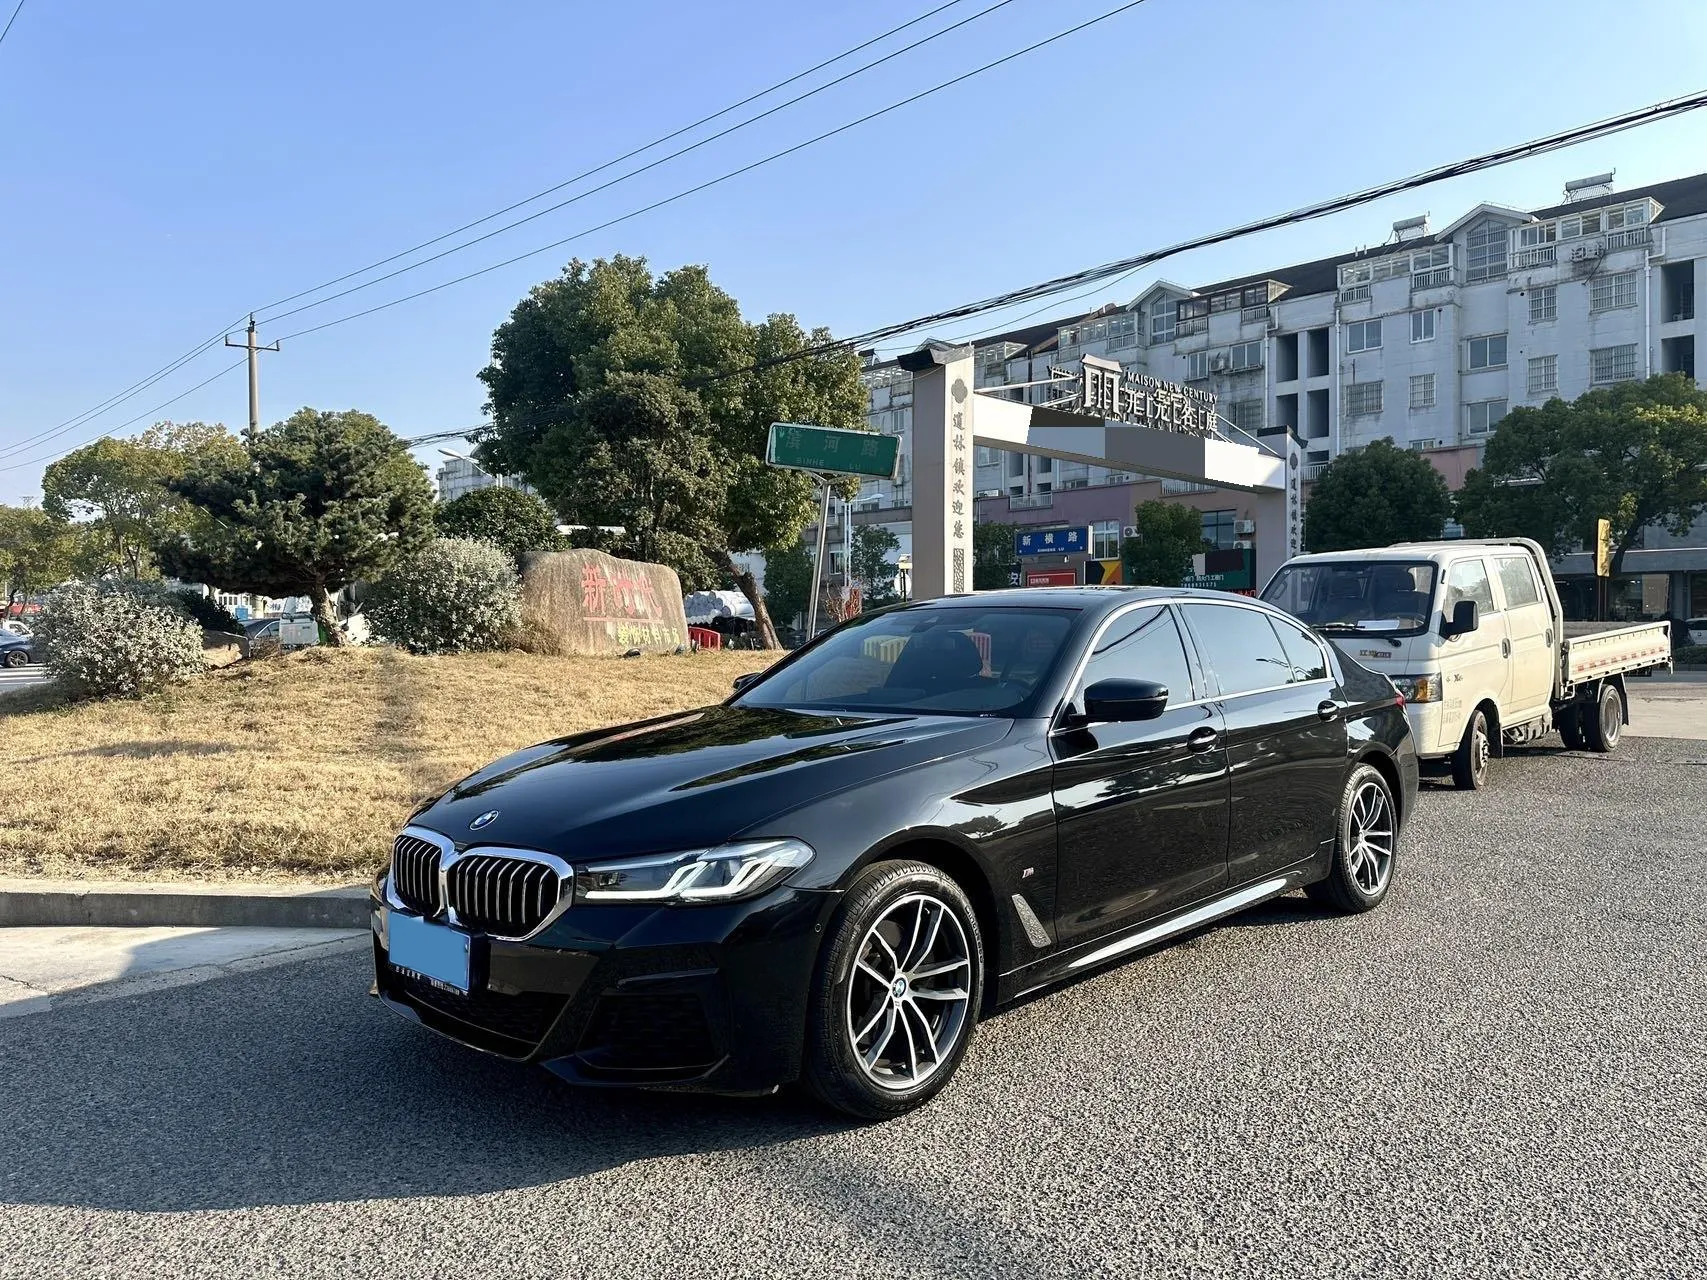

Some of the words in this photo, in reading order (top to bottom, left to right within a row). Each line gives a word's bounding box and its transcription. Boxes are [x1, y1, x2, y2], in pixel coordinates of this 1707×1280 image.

[1127, 371, 1160, 389] MAISON
[1163, 380, 1181, 393] NEW
[1184, 386, 1218, 404] CENTURY
[952, 411, 966, 539] 道林镇欢迎您
[1022, 531, 1078, 546] 新横路
